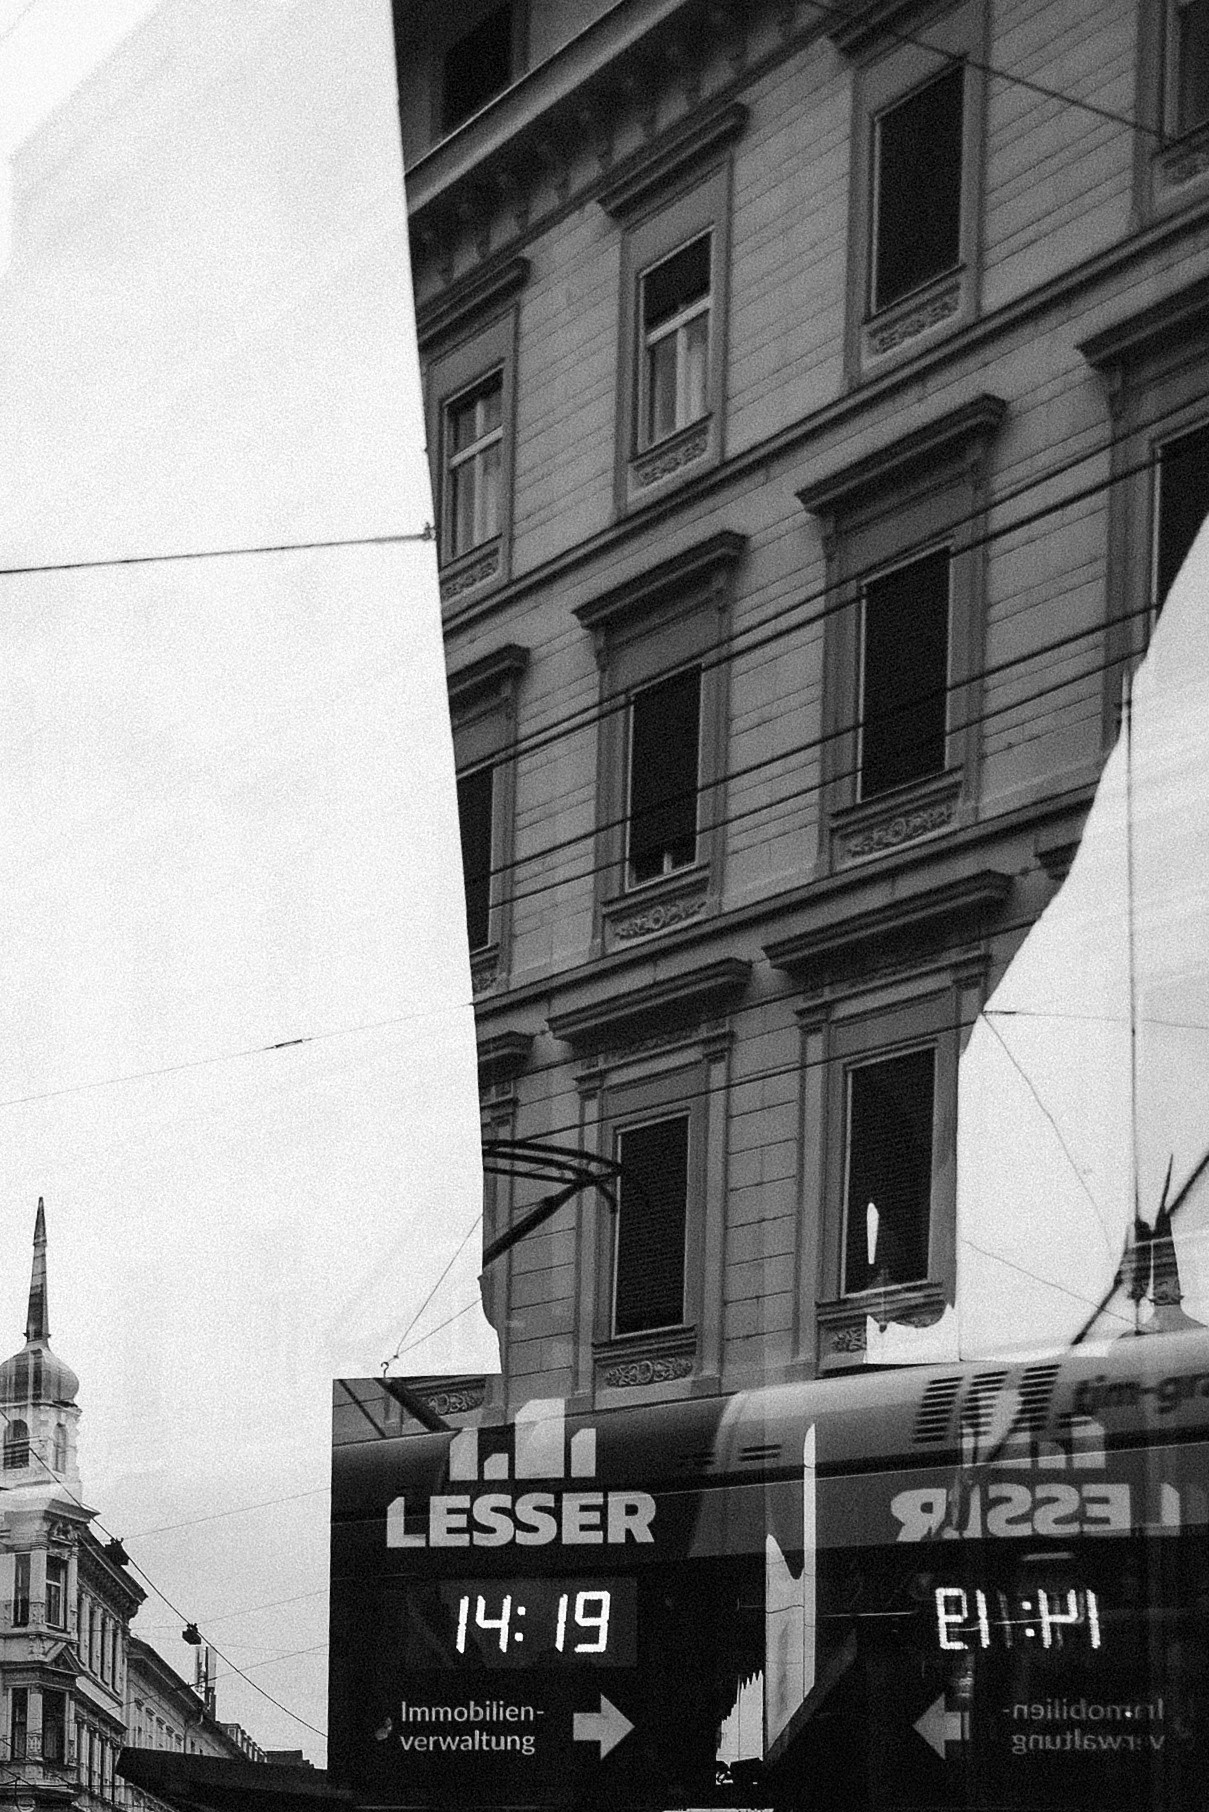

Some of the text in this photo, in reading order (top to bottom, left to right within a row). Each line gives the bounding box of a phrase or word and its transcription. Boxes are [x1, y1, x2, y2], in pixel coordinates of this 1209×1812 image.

[387, 1491, 657, 1548] LESSER
[401, 1700, 546, 1723] Immobilien-
[400, 1729, 536, 1756] verwaltung
